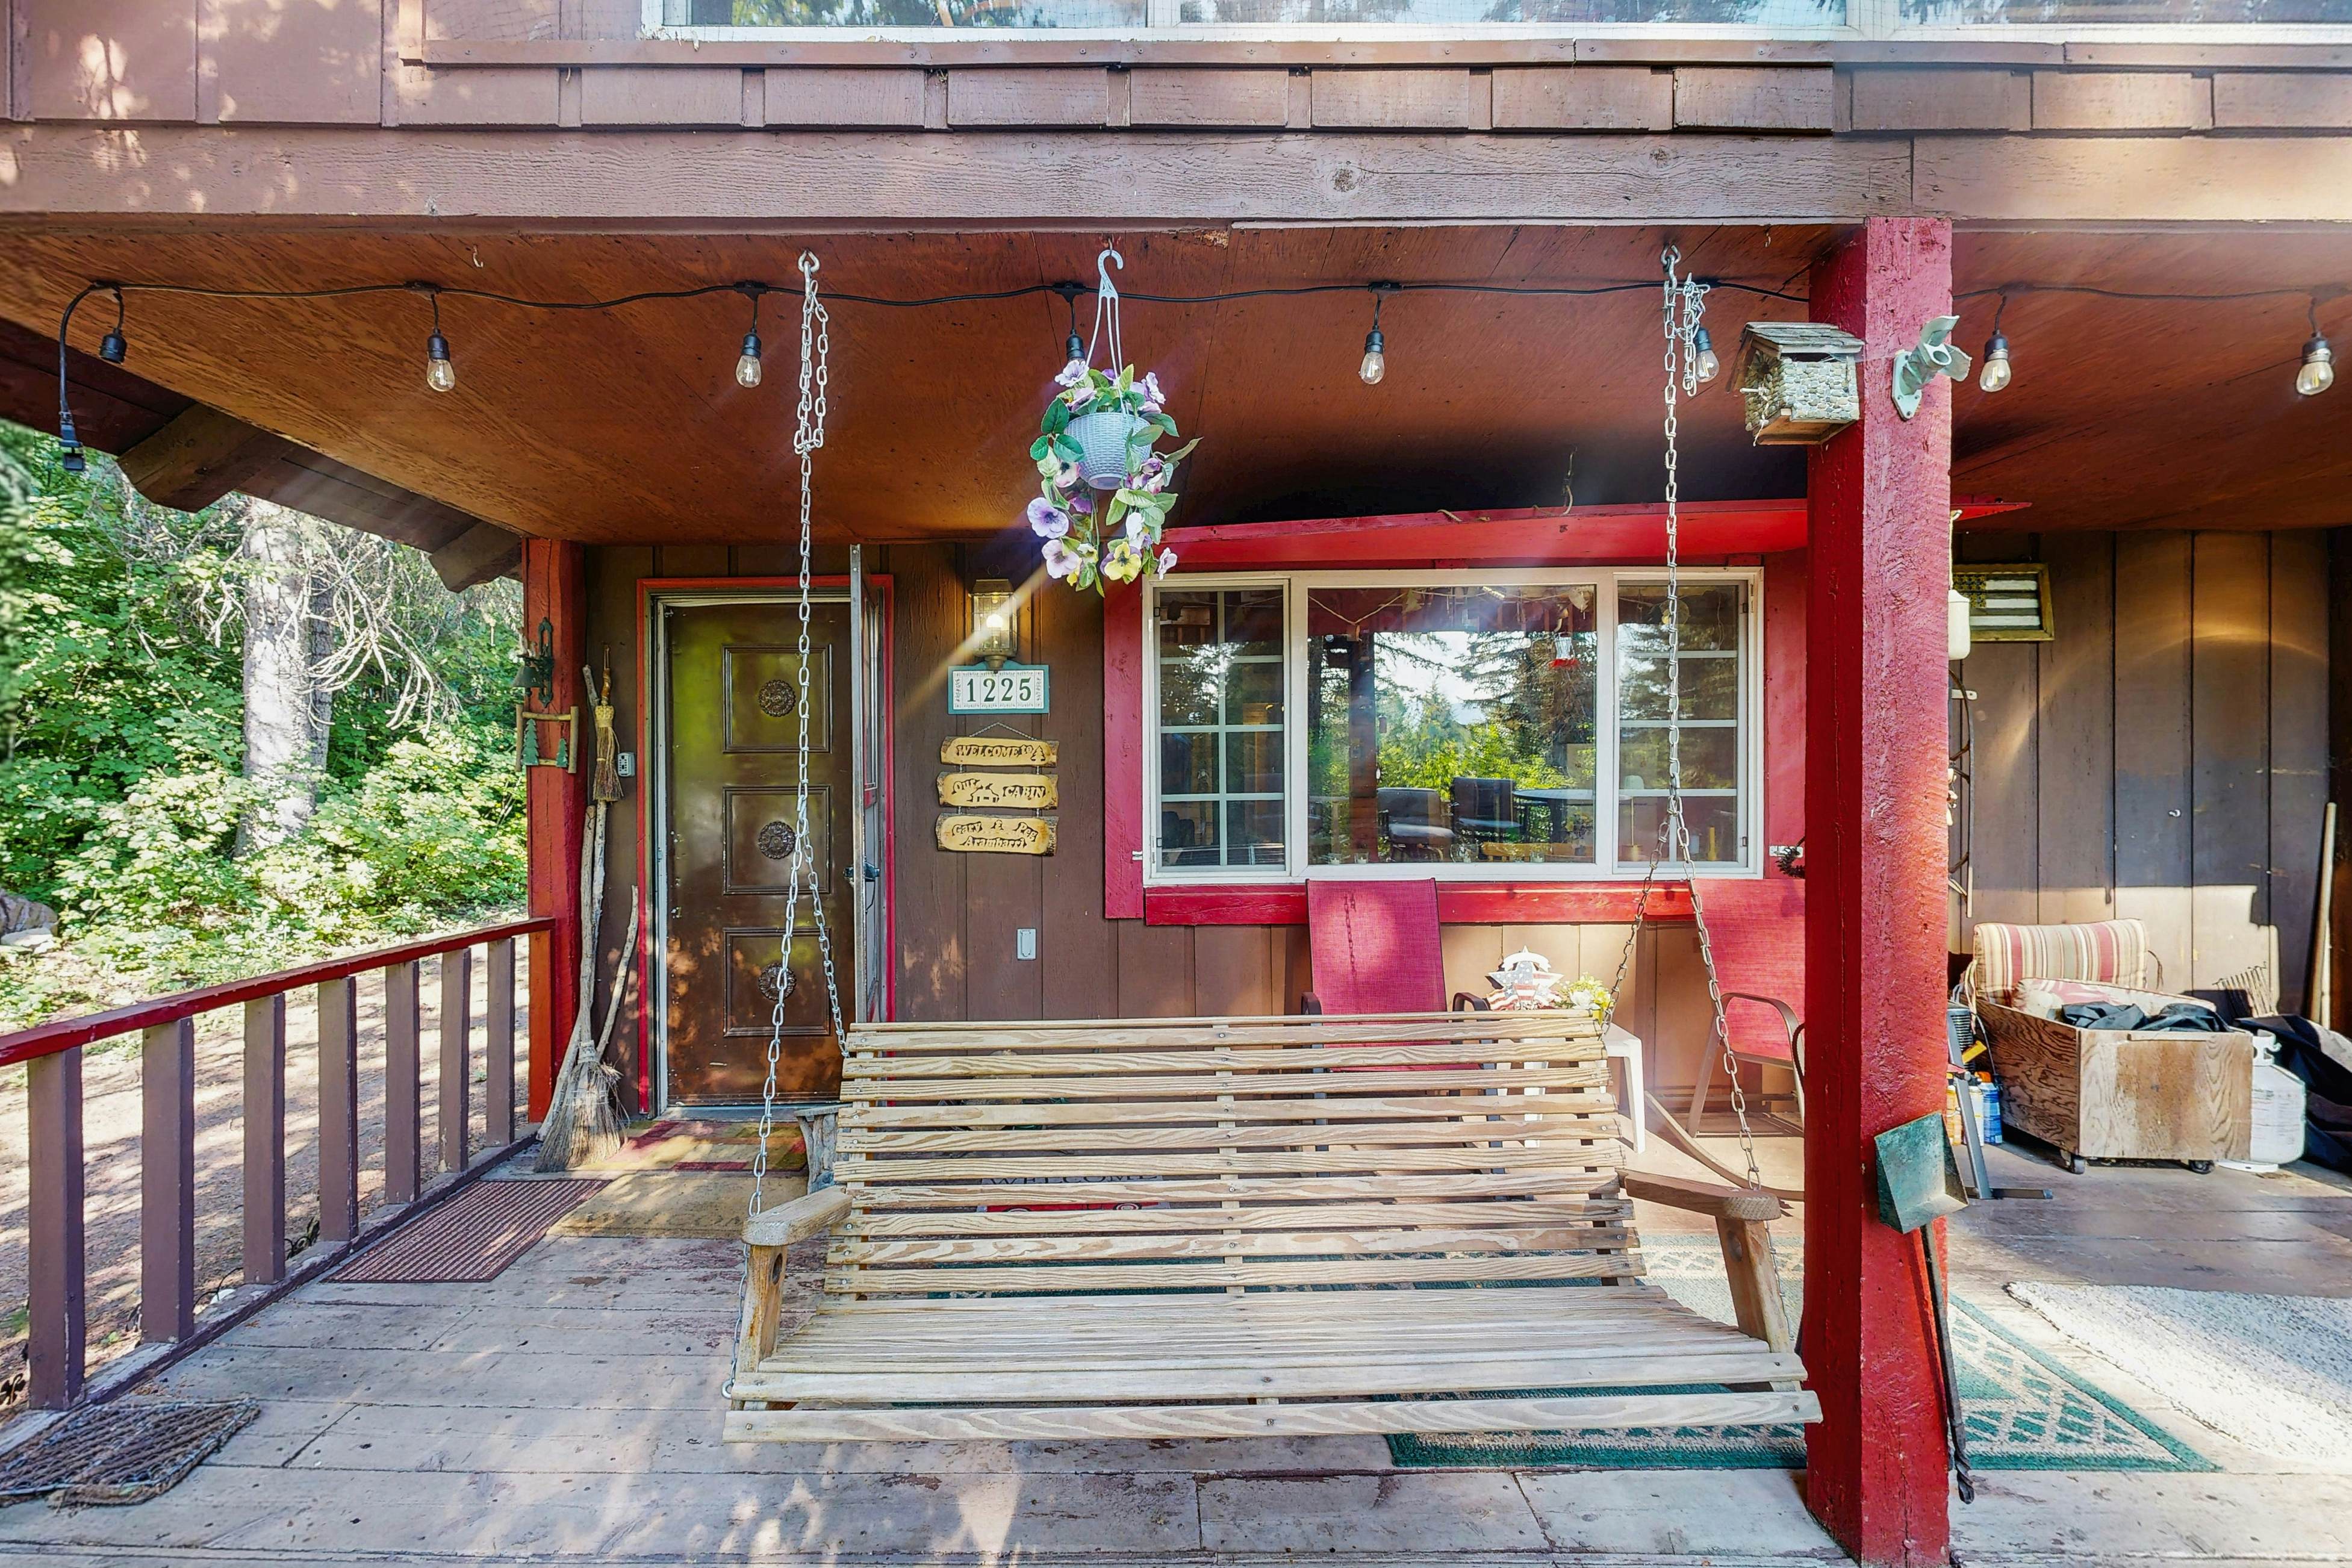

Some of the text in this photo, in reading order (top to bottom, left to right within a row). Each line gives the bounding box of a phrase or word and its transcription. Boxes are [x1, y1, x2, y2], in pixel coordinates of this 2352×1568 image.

[967, 677, 1031, 702] 1225
[957, 744, 1033, 758] WELCOME to
[1003, 785, 1046, 798] CABIN
[952, 821, 983, 836] Gary
[1015, 822, 1039, 842] Peg
